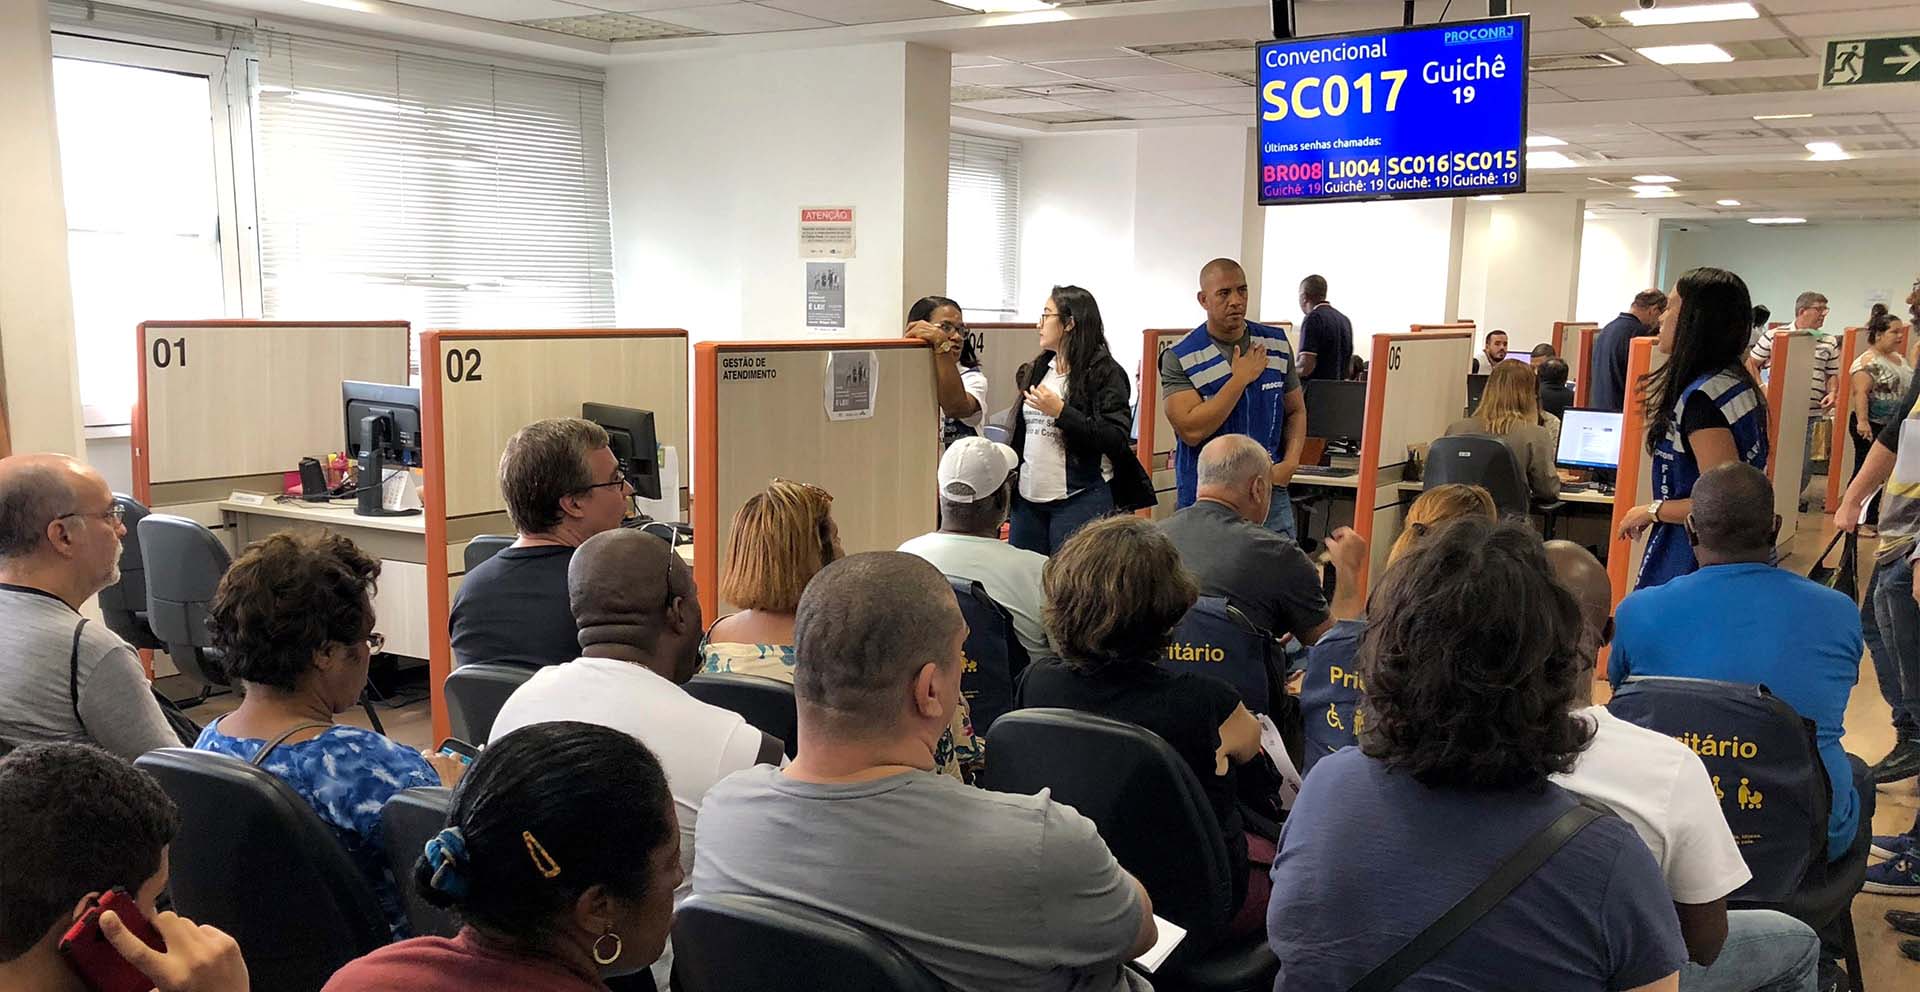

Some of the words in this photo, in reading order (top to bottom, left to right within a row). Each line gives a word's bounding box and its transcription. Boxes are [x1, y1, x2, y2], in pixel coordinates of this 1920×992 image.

[1444, 26, 1515, 43] PROCONRJ
[1265, 38, 1387, 68] Convencional
[1422, 54, 1506, 84] Guichê
[1262, 69, 1408, 122] SC017
[1451, 86, 1476, 104] 19
[1264, 137, 1298, 153] Últimas
[1300, 139, 1331, 151] senhas
[1333, 136, 1382, 149] chamadas:
[1328, 159, 1380, 178] LI004
[1388, 154, 1449, 175] SC016
[1453, 150, 1517, 171] SC015
[1264, 163, 1322, 182] BR008
[1453, 173, 1499, 187] Guichê:
[1503, 172, 1517, 184] 19
[1264, 183, 1304, 197] Guichê:
[1308, 183, 1321, 195] 19
[1325, 180, 1367, 194] Guichê:
[1370, 179, 1384, 192] 19
[1387, 176, 1431, 190] Guichê:
[1435, 175, 1449, 188] 19
[805, 210, 848, 221] ATENÇÃO
[969, 332, 984, 353] 04
[152, 337, 188, 369] 01
[722, 357, 754, 368] GESTÃO
[755, 357, 766, 367] DE
[1389, 346, 1401, 370] 06
[445, 348, 482, 383] 02
[722, 368, 777, 381] ATENDIMENTO
[1168, 642, 1225, 662] itário
[1330, 666, 1366, 692] Pri
[1675, 732, 1758, 758] itário
